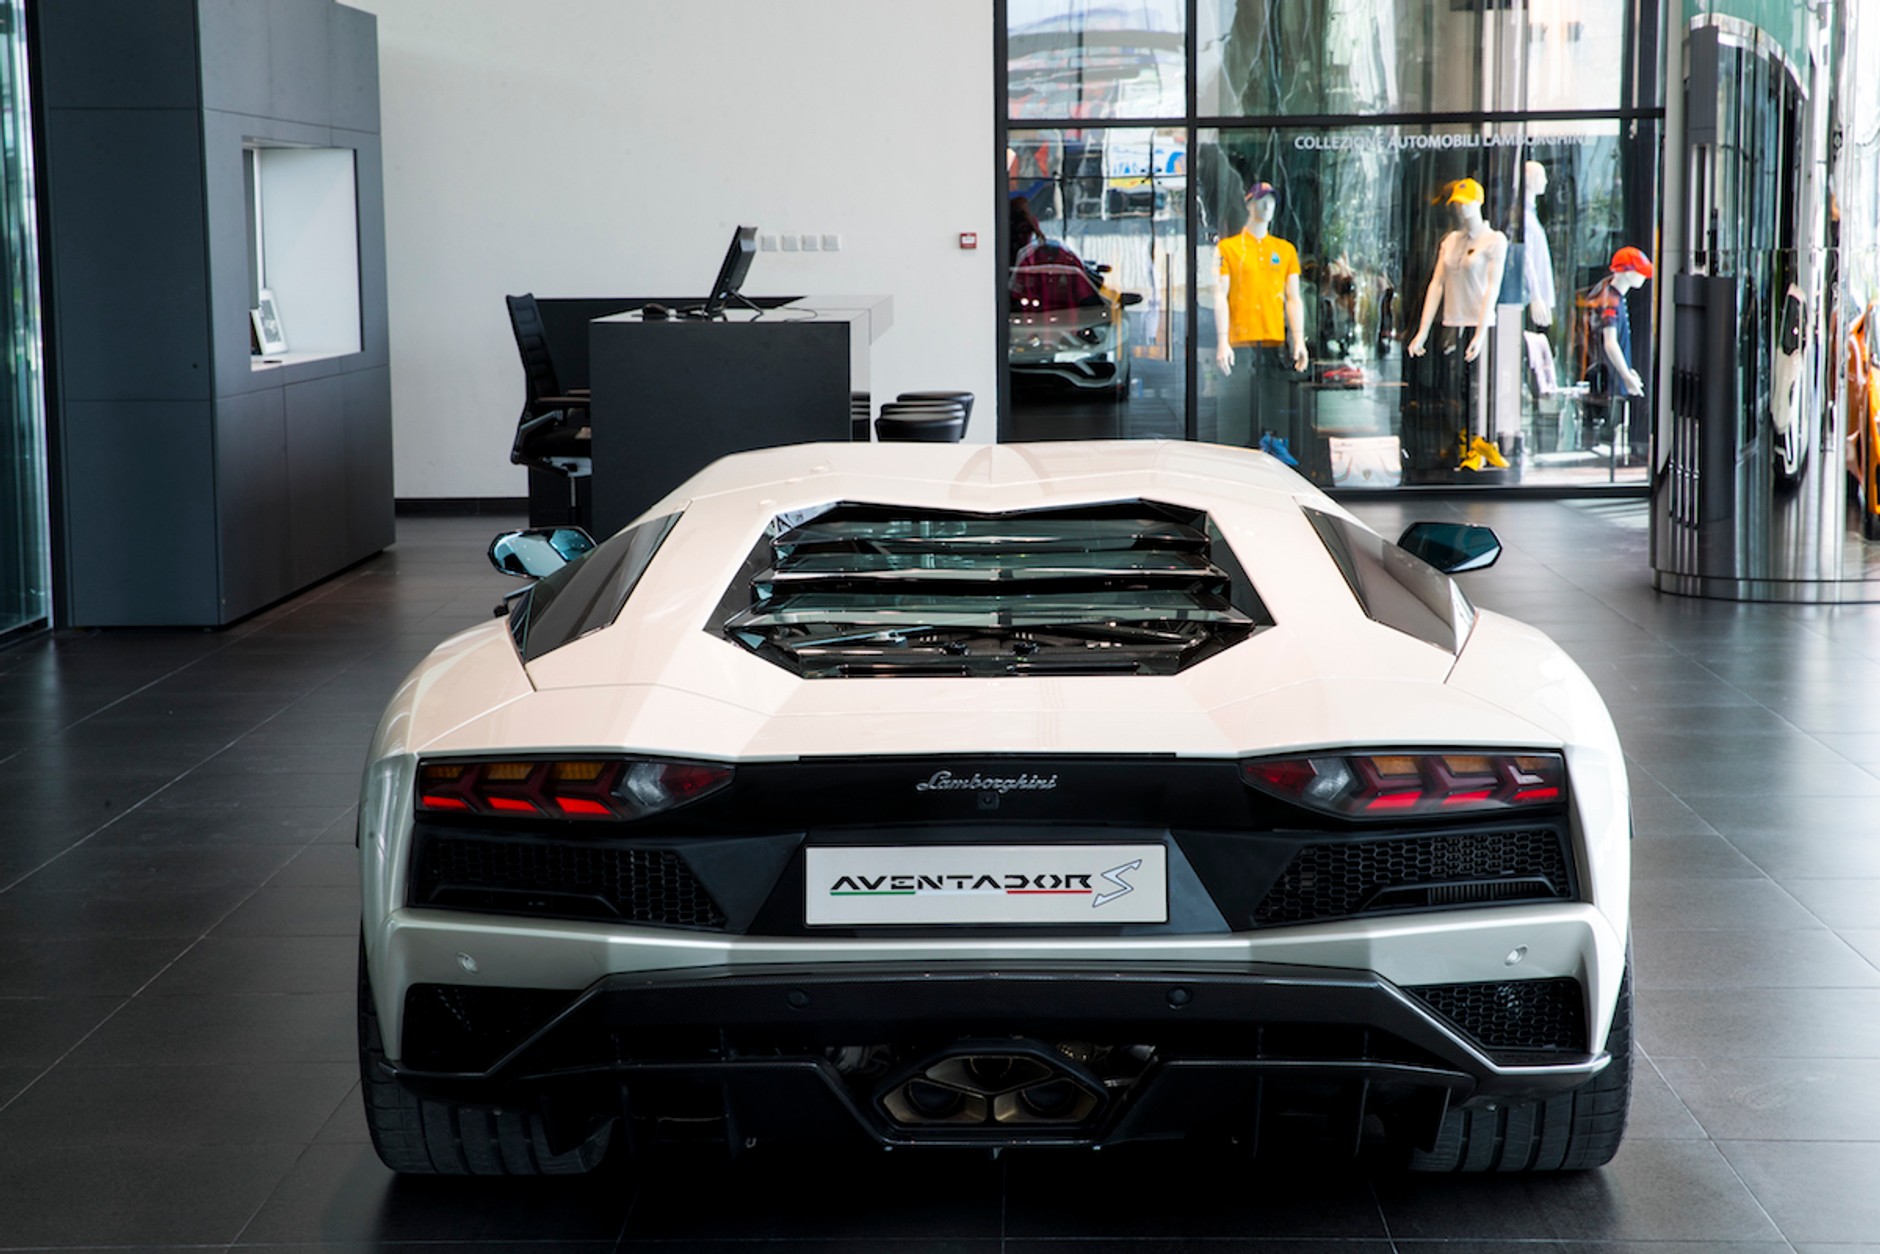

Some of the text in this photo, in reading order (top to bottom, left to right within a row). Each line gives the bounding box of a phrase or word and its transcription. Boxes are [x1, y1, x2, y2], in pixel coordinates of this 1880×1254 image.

[1294, 135, 1384, 150] COLLEZIONE
[1388, 134, 1479, 149] AUTOMOBILI
[916, 770, 1058, 793] Lamborghini
[830, 874, 1092, 891] AVENTADOR
